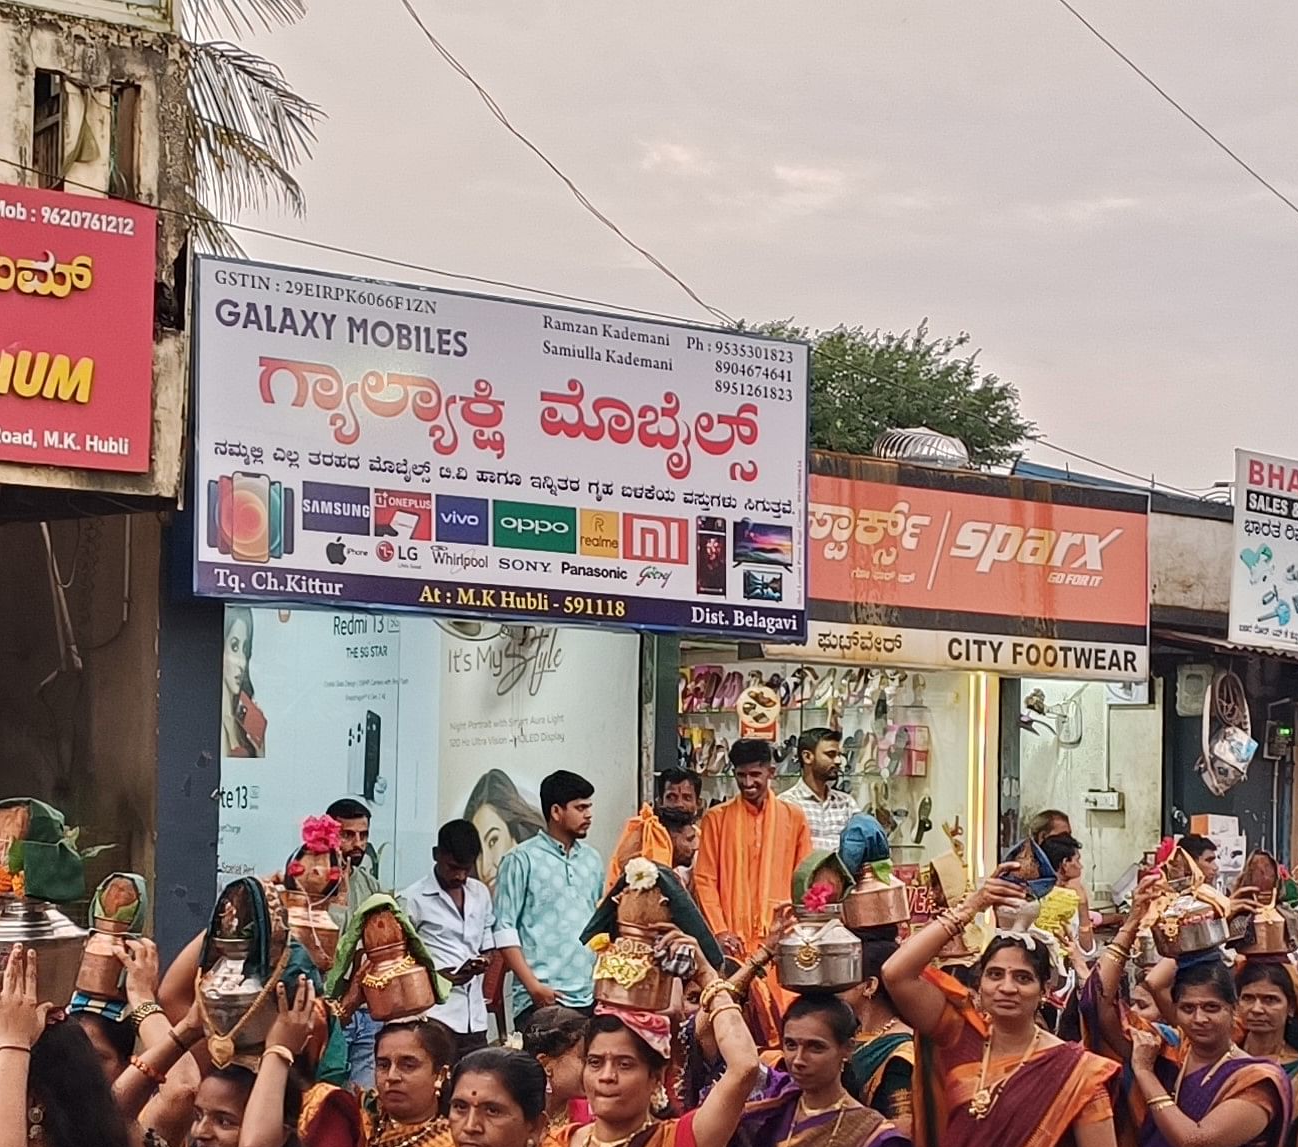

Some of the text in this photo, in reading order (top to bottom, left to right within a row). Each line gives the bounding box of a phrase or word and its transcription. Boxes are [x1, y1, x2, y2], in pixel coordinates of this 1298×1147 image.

[41, 206, 135, 235] 9620761212
[215, 270, 271, 290] GSTIN
[215, 299, 468, 357] GALAXY MOBILES
[543, 314, 670, 347] Ramzan Kademani
[543, 340, 673, 372] Samiulla Kademani
[687, 336, 704, 351] Ph
[715, 341, 793, 363] 9535301823
[715, 360, 792, 382] 8904674641
[715, 379, 793, 402] 8951261823
[258, 356, 506, 460] ಗ್ಯಾಲ್ಯಾಕ್ಷಿ
[43, 431, 81, 450] M.K.
[86, 434, 130, 455] Hubli
[214, 440, 264, 466] ನಮ್ಮಲ್ಲಿ
[273, 448, 300, 468] ಎಲ್ಲ
[308, 451, 360, 470] ತರಹದ
[476, 470, 522, 486] ಹಾಗೂ
[530, 475, 580, 496] ಇನ್ನಿತರ
[303, 499, 370, 518] SAMSUNG
[388, 496, 431, 510] ONEPLUS
[1248, 493, 1289, 516] SALES
[440, 510, 480, 526] vivo
[1244, 518, 1281, 539] ಭಾರತ
[398, 545, 418, 562] LG
[580, 534, 619, 550] realme
[950, 519, 1124, 573] sparx
[433, 546, 489, 571] Whirlpool
[499, 557, 551, 573] SONY
[214, 568, 344, 596] Tq. Ch.Kittur
[561, 561, 629, 580] Panasonic
[1047, 572, 1104, 587] GO FOR IT
[419, 584, 442, 604] At
[457, 587, 496, 608] M.K
[500, 590, 549, 612] Hubli
[563, 596, 626, 618] 591118
[333, 615, 368, 636] Redmi
[691, 605, 799, 635] Dist. Belagavi
[448, 649, 472, 673] It's
[477, 645, 502, 677] My
[948, 637, 1138, 673] CITY FOOTWEAR
[235, 786, 248, 809] 13
